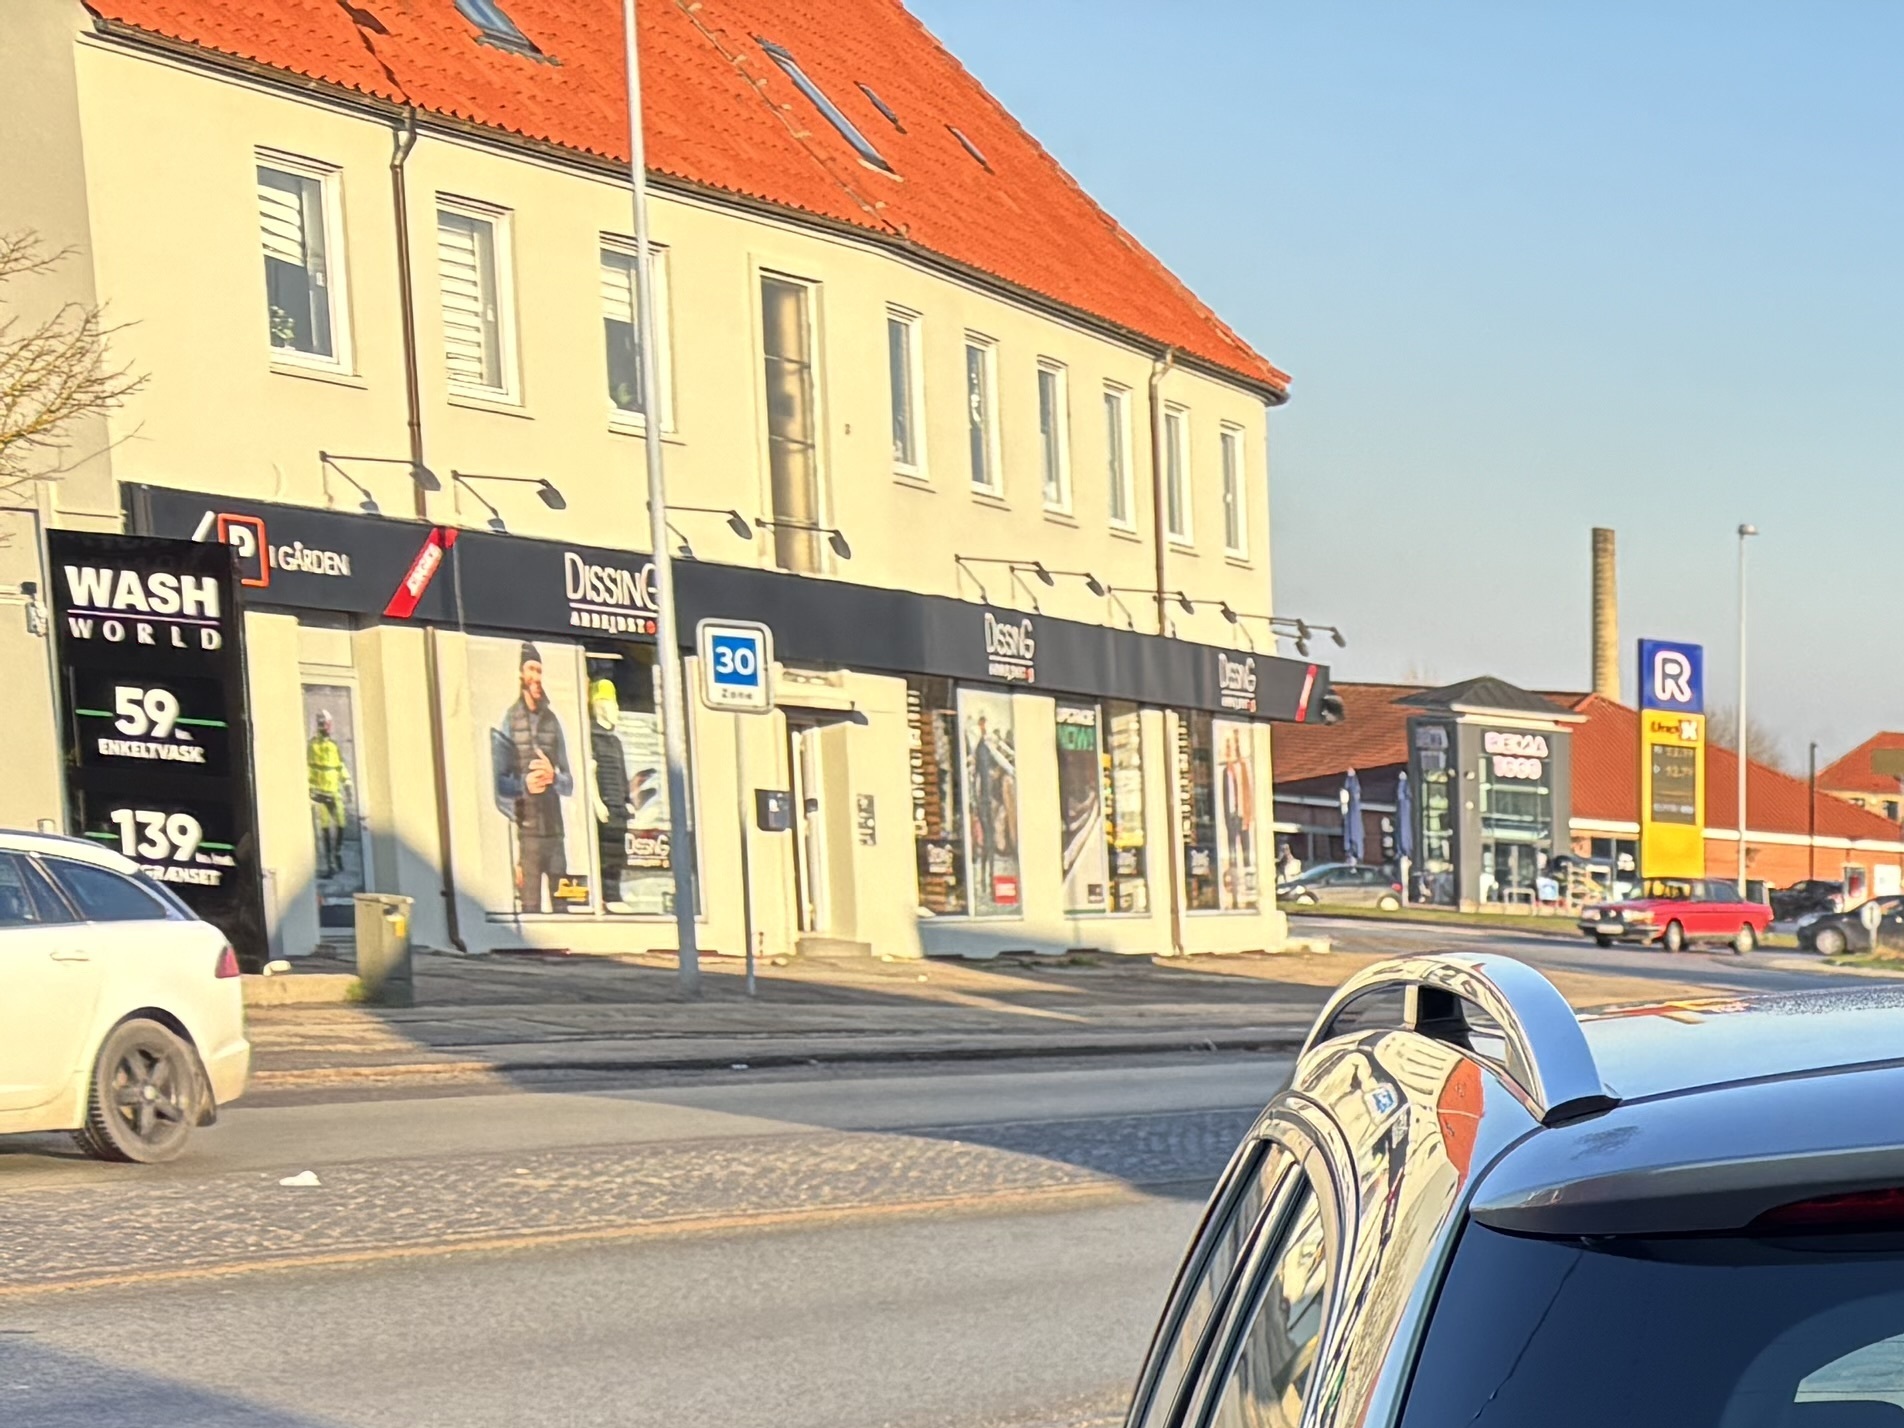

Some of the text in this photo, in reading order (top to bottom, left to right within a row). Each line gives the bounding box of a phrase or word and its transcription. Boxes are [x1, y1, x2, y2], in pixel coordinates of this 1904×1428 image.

[278, 541, 351, 577] GÅRDEN
[64, 565, 221, 618] WASH
[68, 616, 222, 652] WORLD
[715, 645, 755, 676] 30
[1654, 650, 1692, 703] R
[110, 807, 203, 863] 139
[140, 864, 223, 886] GRÆNSET
